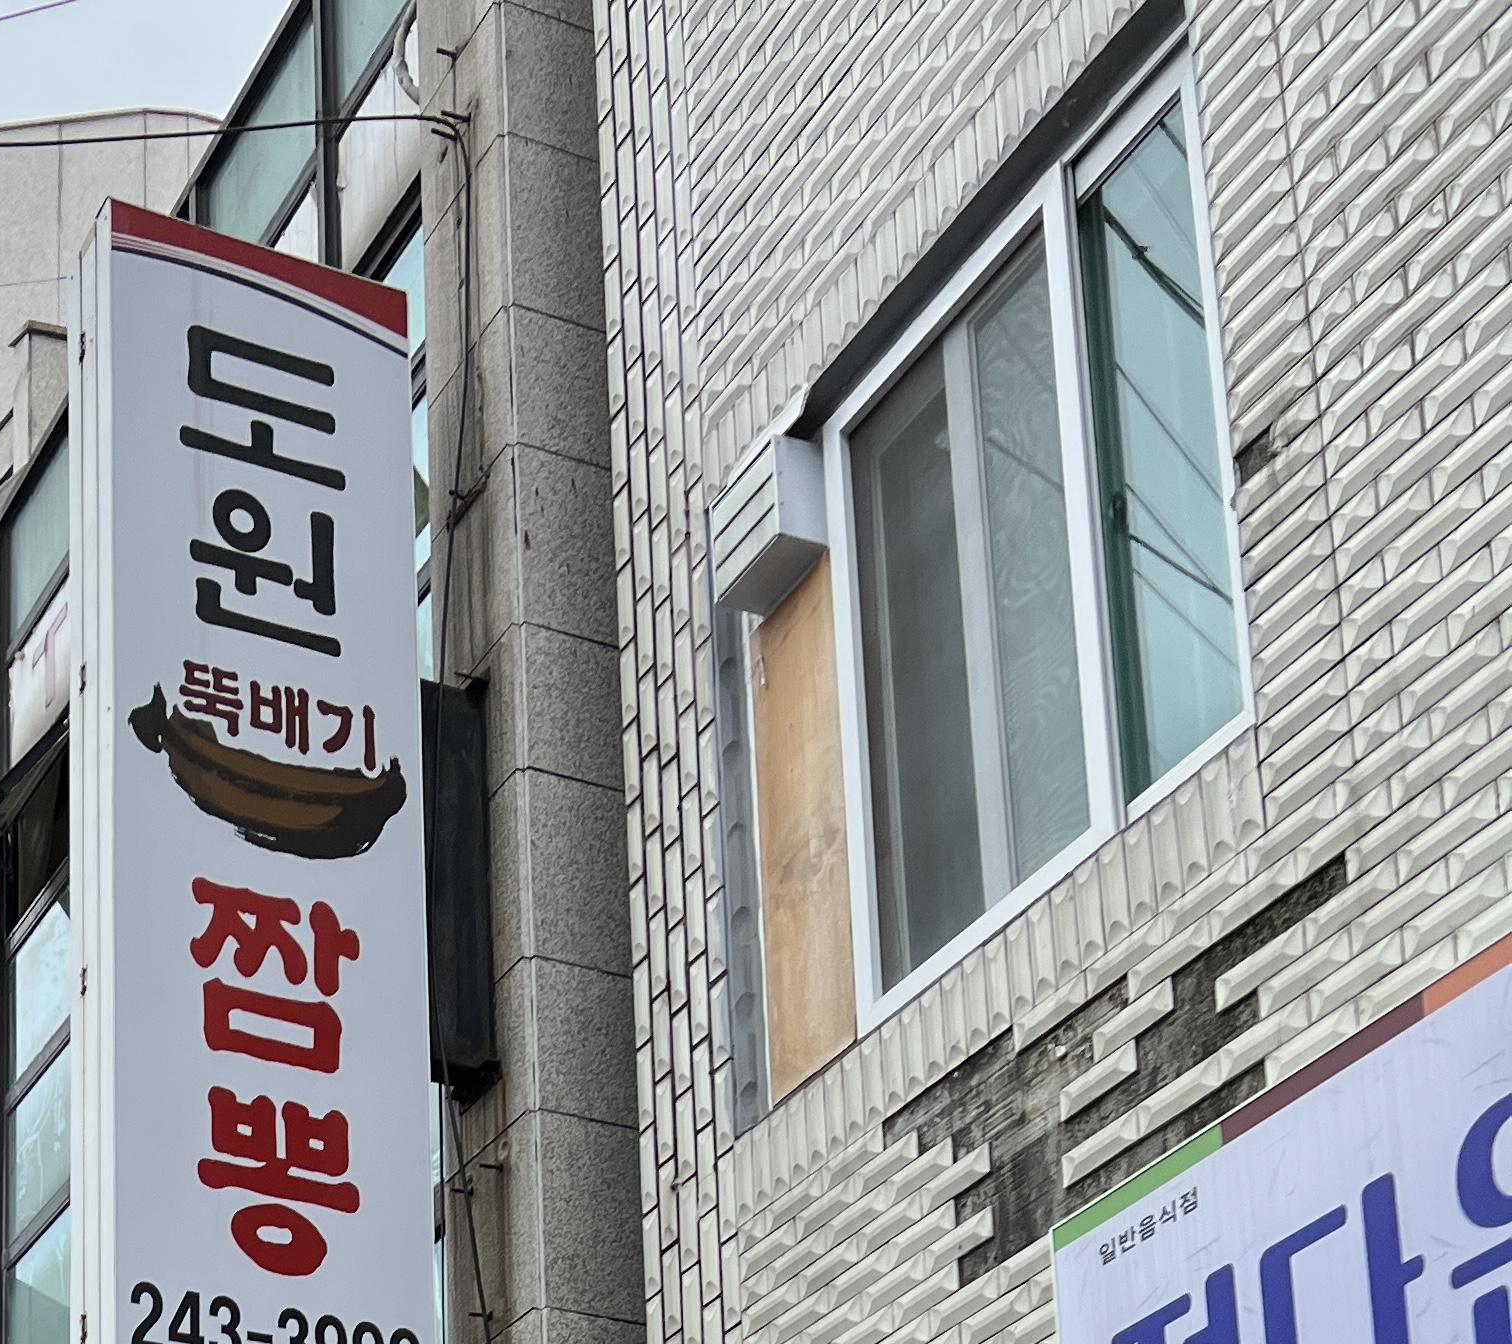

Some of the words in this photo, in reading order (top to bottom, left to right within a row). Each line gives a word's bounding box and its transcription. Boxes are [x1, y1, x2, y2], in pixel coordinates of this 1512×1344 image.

[179, 325, 346, 657] 도원
[178, 659, 376, 772] 뚝배기
[190, 876, 361, 1277] 짬뽕
[1098, 1187, 1200, 1266] 일반음식점
